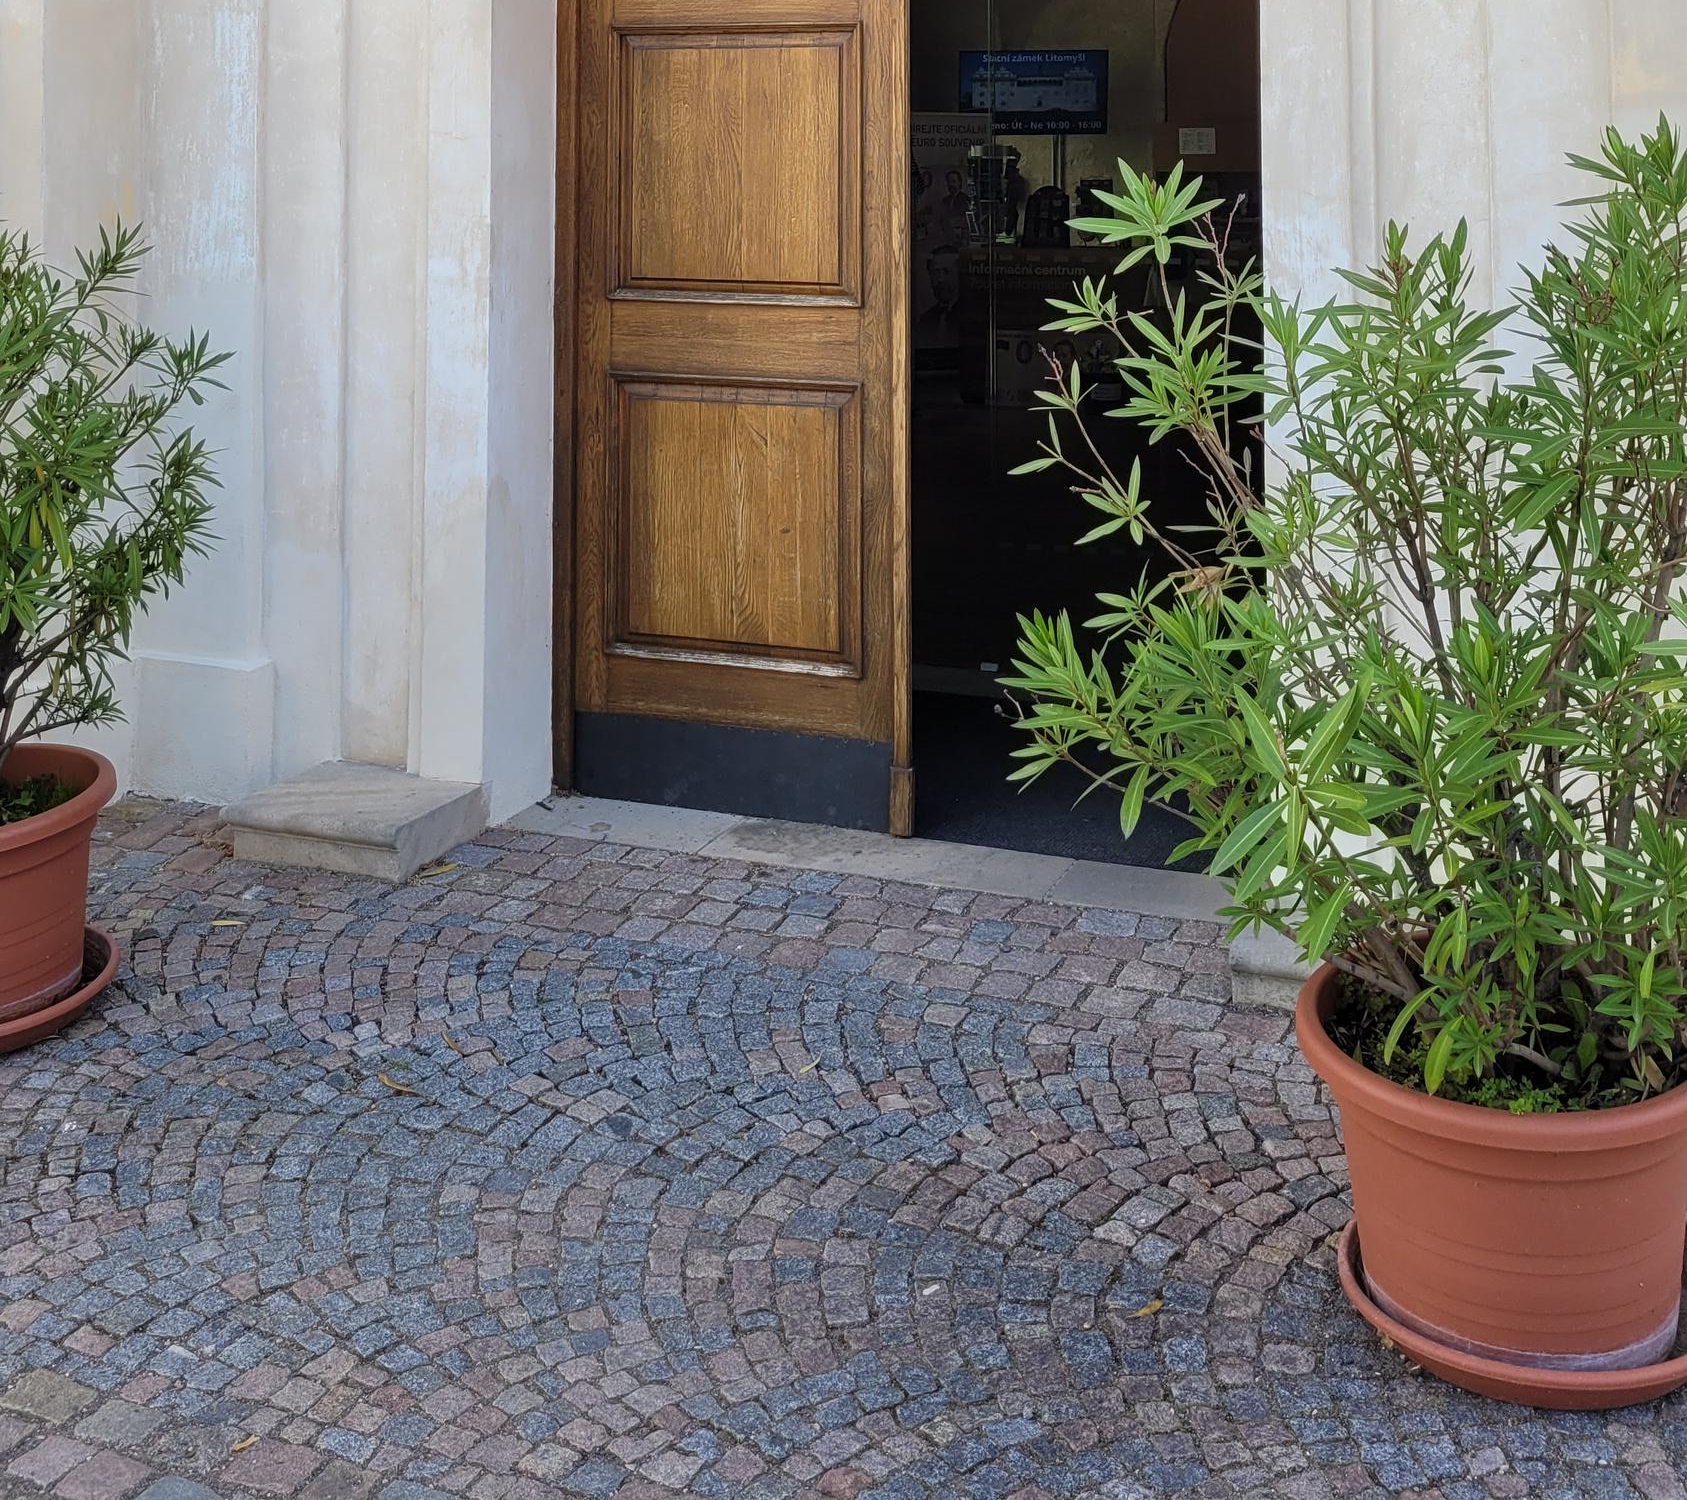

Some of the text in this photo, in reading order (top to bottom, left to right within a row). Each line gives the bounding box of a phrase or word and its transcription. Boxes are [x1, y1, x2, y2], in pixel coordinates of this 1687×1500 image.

[1046, 53, 1086, 64] Litomyšl
[912, 123, 942, 135] ÍREJTE
[968, 263, 1086, 276] Infomační centrum
